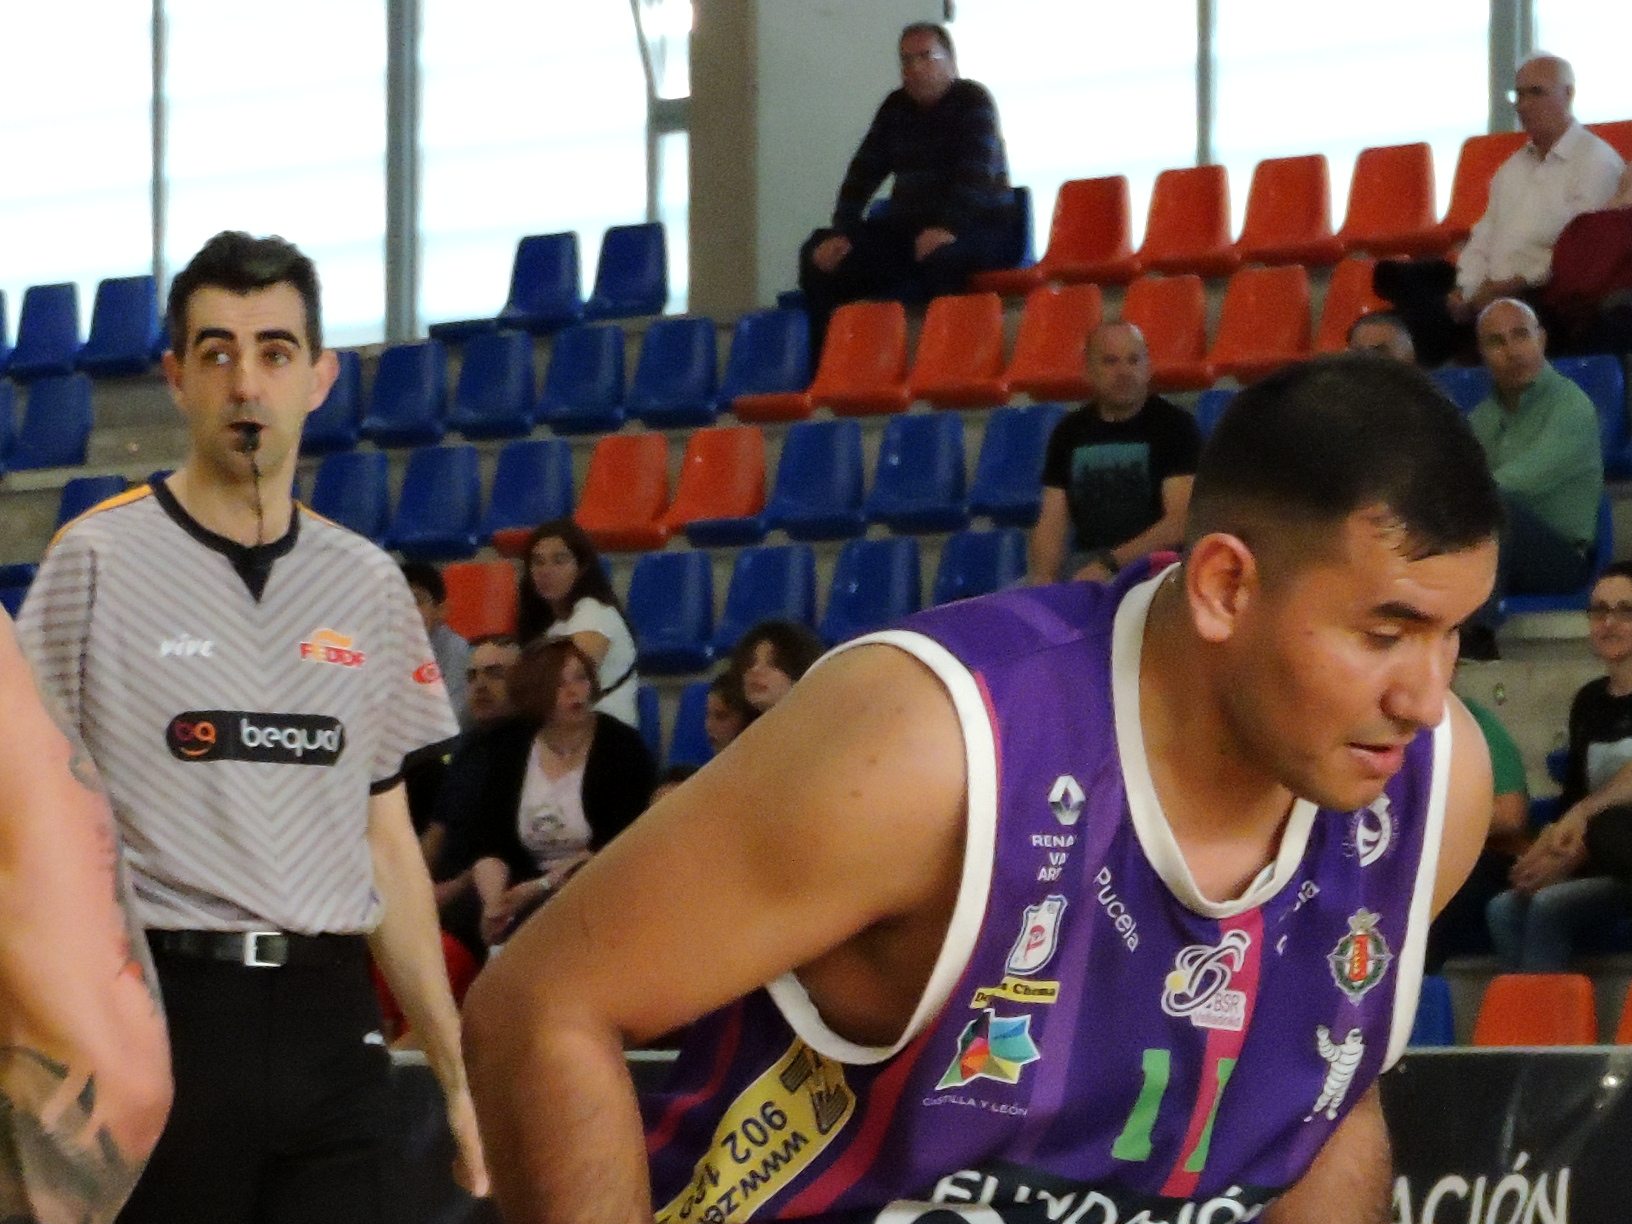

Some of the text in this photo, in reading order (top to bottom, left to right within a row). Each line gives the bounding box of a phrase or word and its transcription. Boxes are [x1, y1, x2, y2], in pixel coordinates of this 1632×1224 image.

[1032, 834, 1077, 848] RENA
[1093, 866, 1140, 953] Pucela
[721, 1100, 788, 1165] 902
